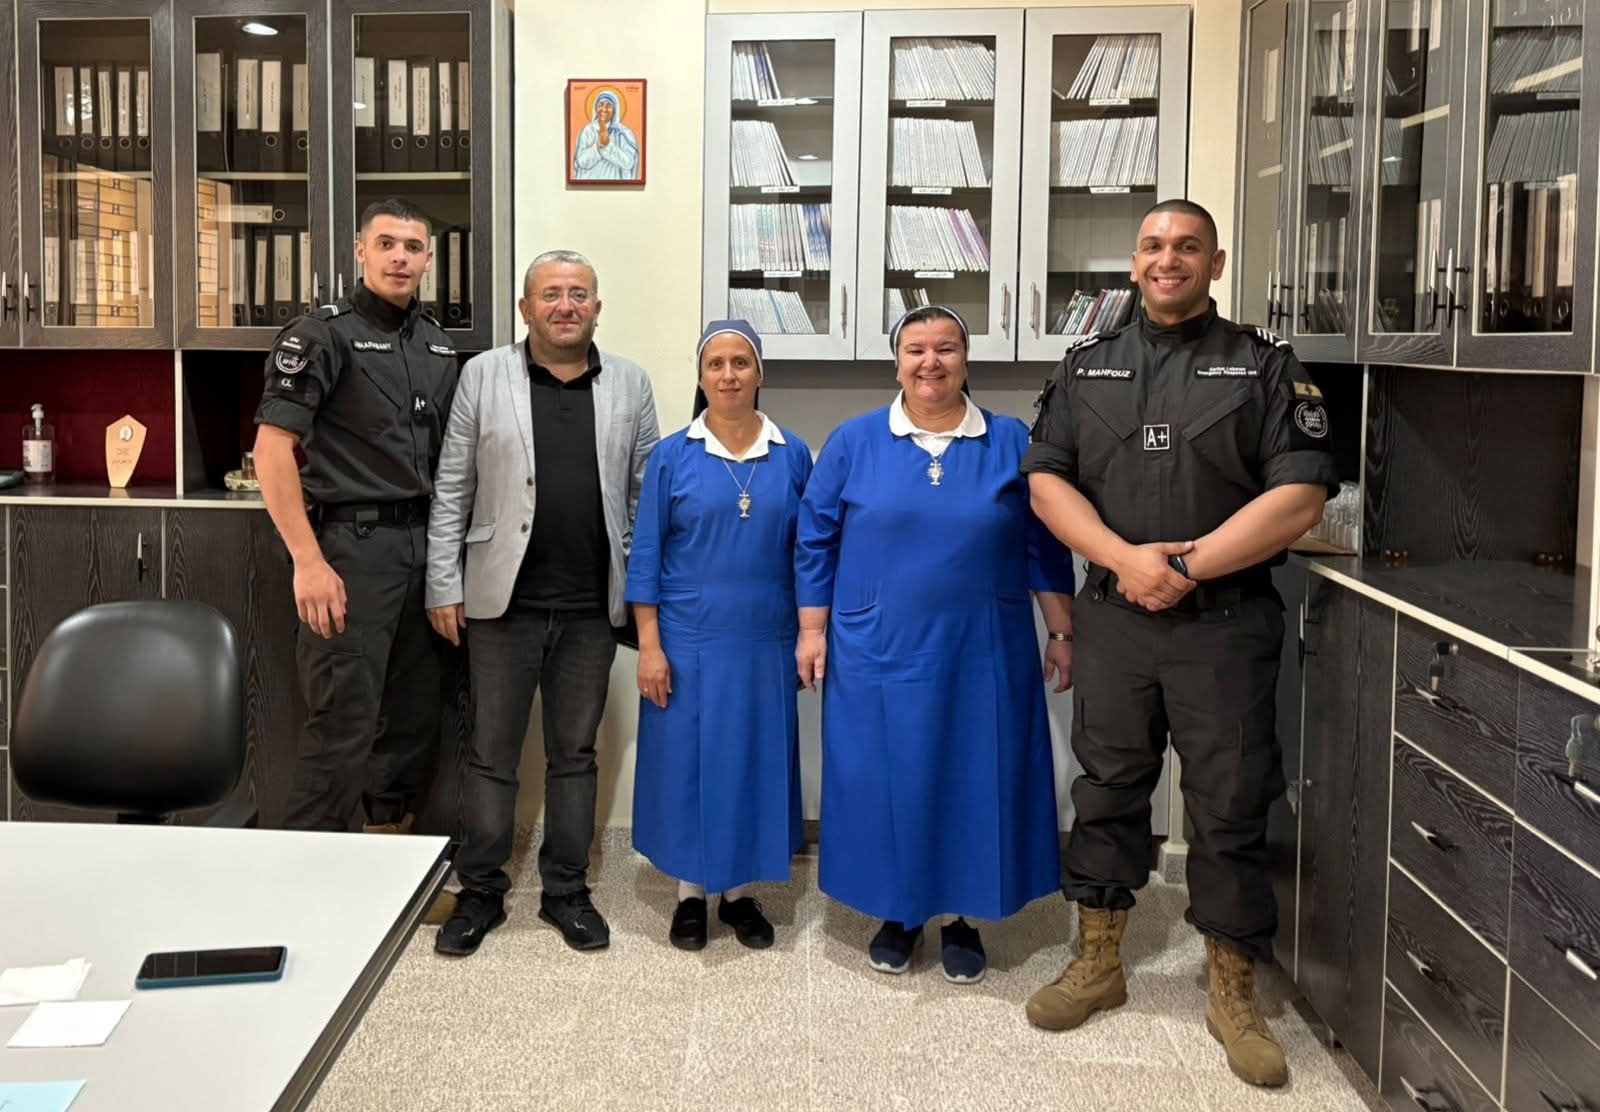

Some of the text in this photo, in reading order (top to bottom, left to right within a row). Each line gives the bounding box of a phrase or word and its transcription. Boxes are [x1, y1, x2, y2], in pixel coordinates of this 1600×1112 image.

[1076, 368, 1131, 378] P. MAHFOUZ
[414, 396, 426, 411] A+
[1146, 427, 1167, 447] A+
